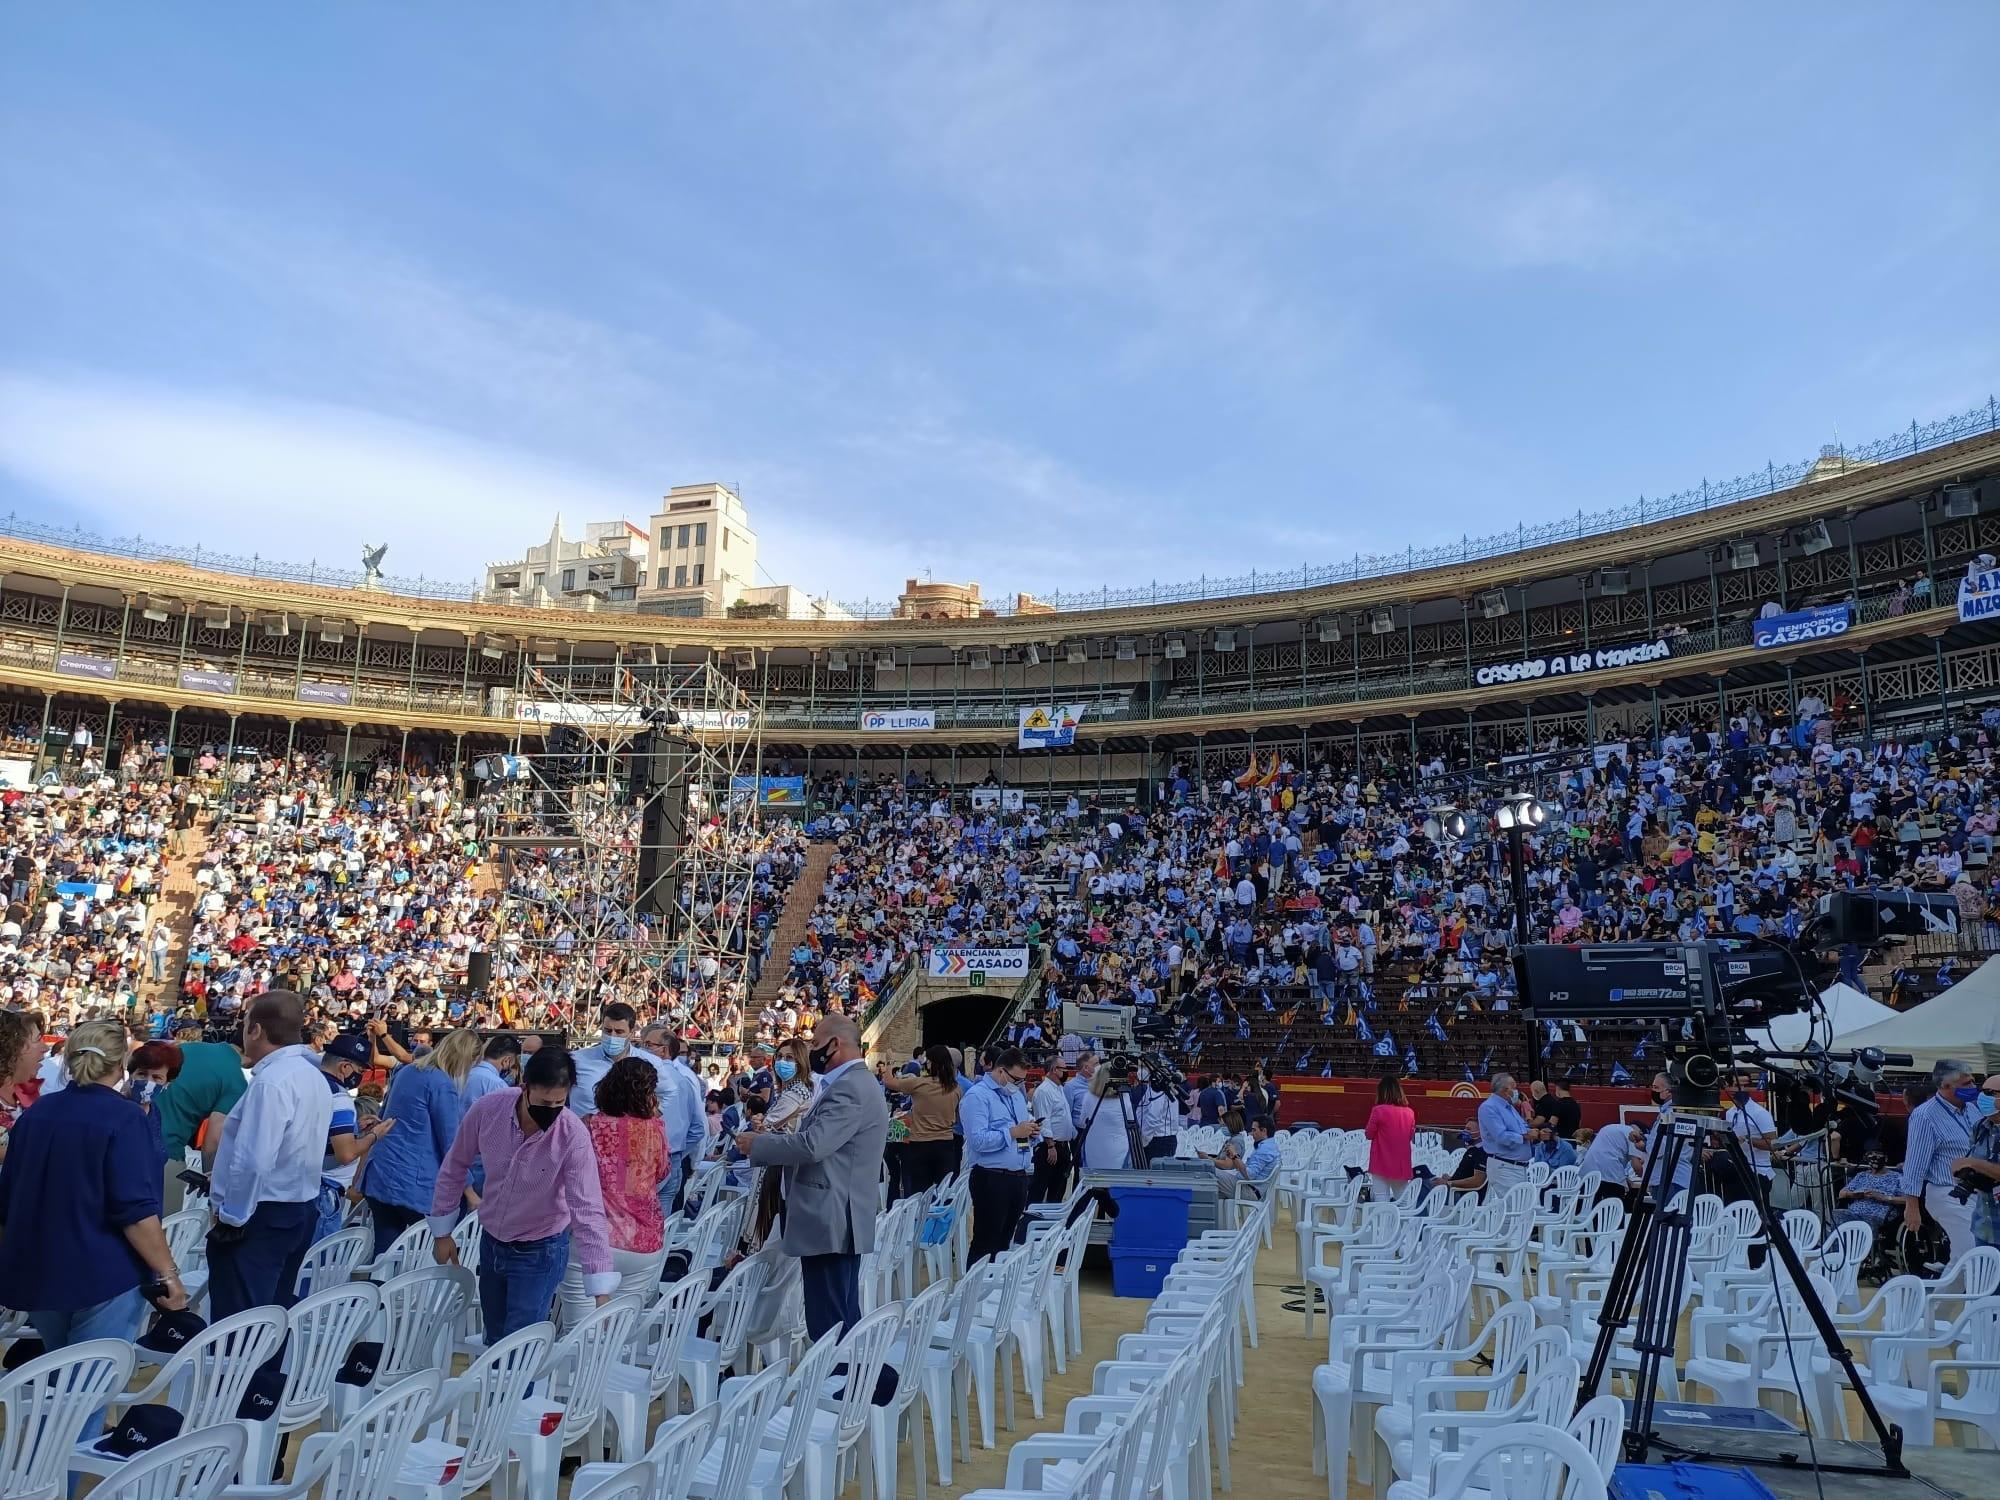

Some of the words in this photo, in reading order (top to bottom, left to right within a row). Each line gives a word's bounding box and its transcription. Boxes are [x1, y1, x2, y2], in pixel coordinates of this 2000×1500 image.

[1777, 617, 1834, 633] BENIDORM
[1758, 620, 1848, 647] CASADO
[1476, 659, 1546, 684] CASADO
[1551, 656, 1566, 674] A
[1570, 653, 1592, 672] LA
[891, 717, 930, 728] LLIRIA
[966, 958, 1023, 969] CASADO
